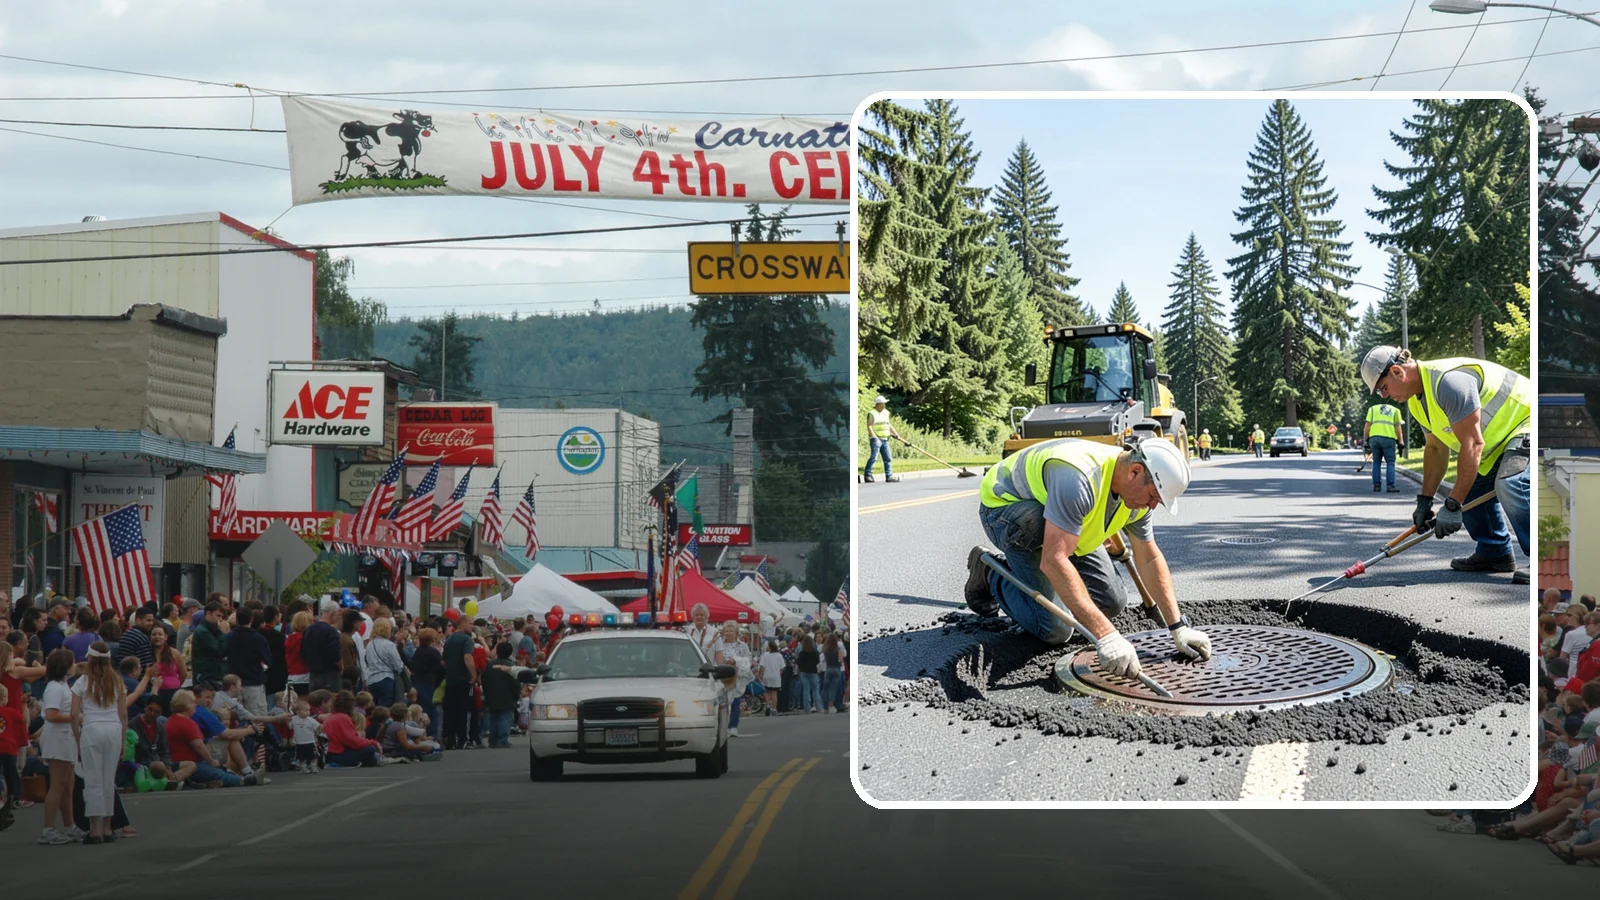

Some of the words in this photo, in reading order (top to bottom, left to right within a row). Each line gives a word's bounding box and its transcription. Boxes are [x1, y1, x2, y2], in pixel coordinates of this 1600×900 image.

[481, 141, 604, 193] JULY
[632, 150, 746, 198] 4th.
[697, 254, 850, 280] CROSSWA
[282, 380, 374, 420] ACE
[405, 408, 453, 422] CEDAR
[283, 421, 371, 436] Hardware
[416, 427, 477, 447] Coca-Cola
[96, 485, 124, 494] Vincent
[126, 485, 135, 494] de
[138, 486, 155, 495] Paul
[688, 526, 741, 535] CRNATION
[699, 535, 730, 543] GLASS
